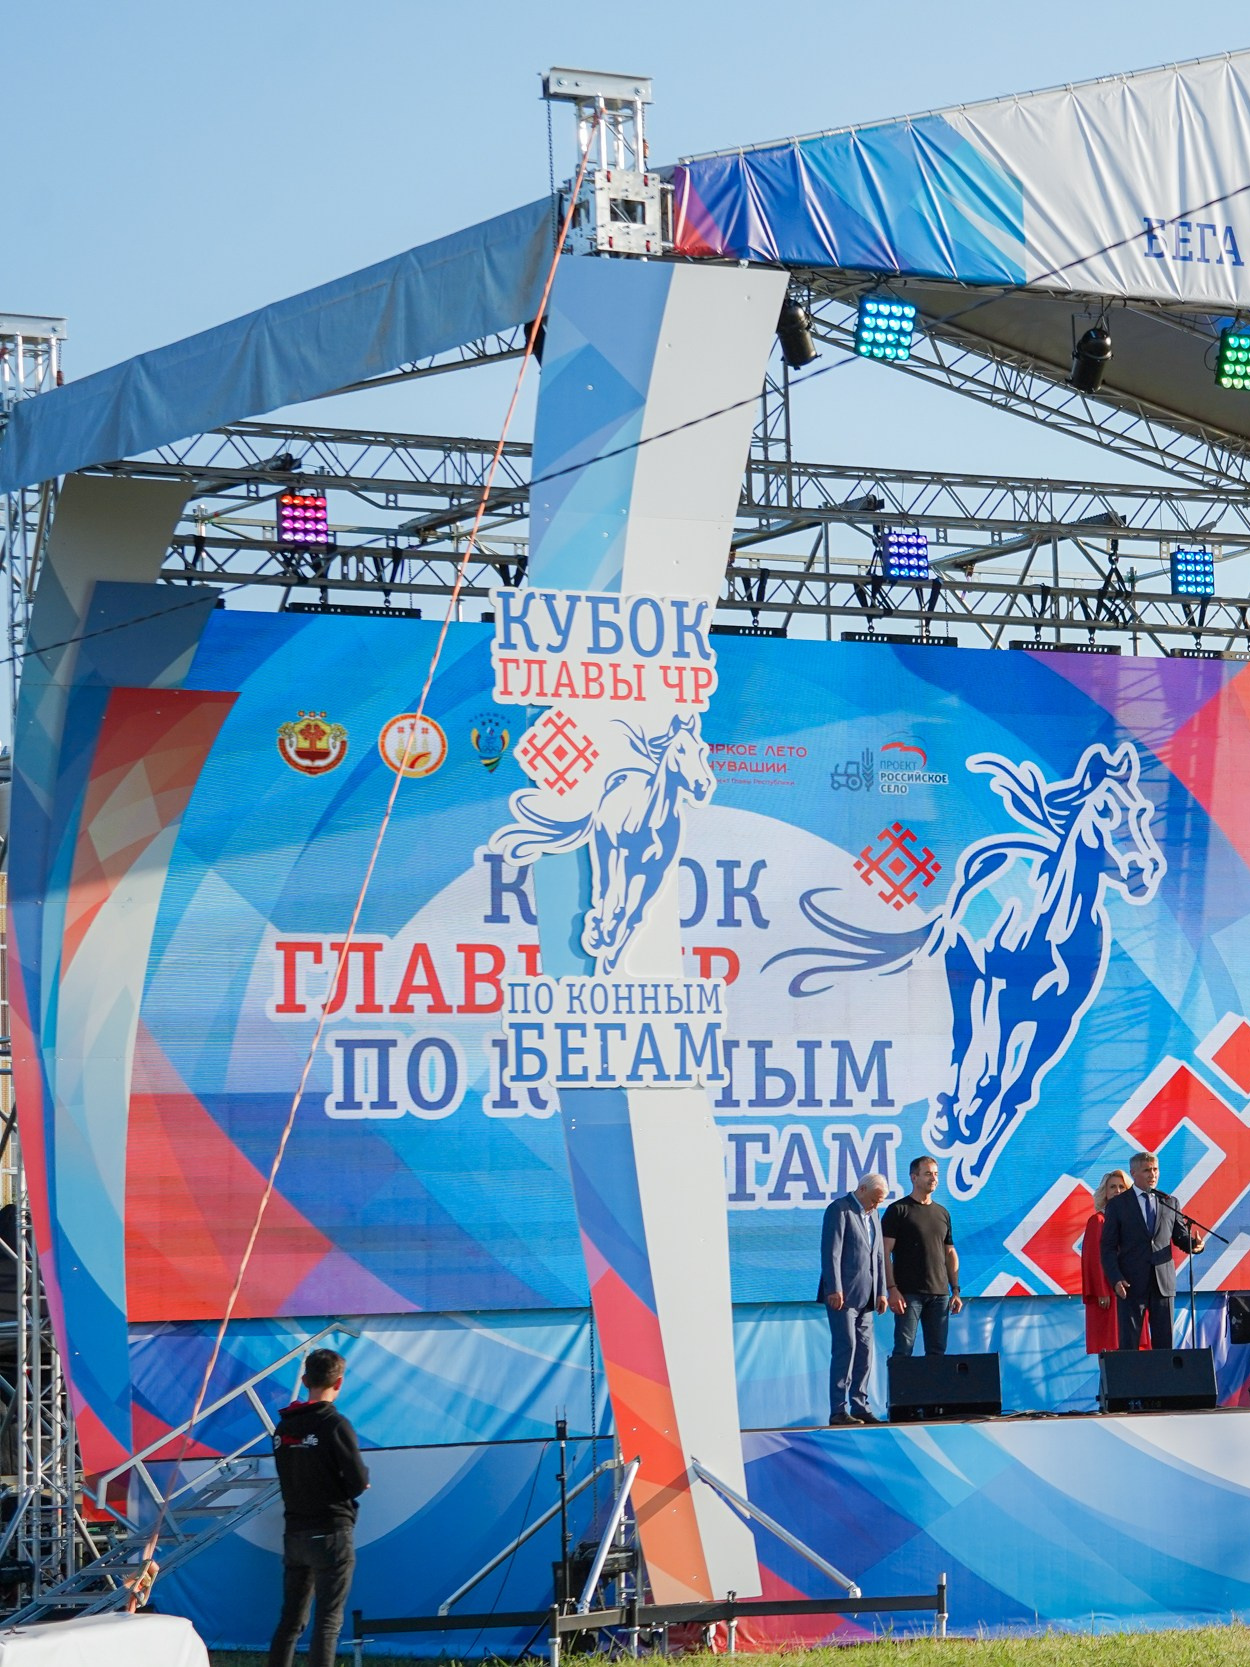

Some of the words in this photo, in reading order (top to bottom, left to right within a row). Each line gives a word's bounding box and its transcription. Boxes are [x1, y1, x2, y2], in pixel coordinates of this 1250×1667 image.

[1143, 217, 1245, 267] БЕГА
[496, 591, 712, 661] КУБОК
[498, 658, 647, 702] ГЛАВЫ
[659, 665, 713, 704] ЧР
[764, 745, 808, 758] ЛЕТО
[880, 760, 917, 771] ПРОЕКТ
[880, 772, 948, 784] РОССИЙСКОЕ
[881, 784, 908, 794] СЕЛО
[275, 941, 543, 1014] ГЛАВ
[507, 982, 554, 1015] ПО
[566, 983, 723, 1015] КОННЫМ
[335, 1038, 458, 1111] ПО
[508, 1022, 725, 1083] БЕГАМ
